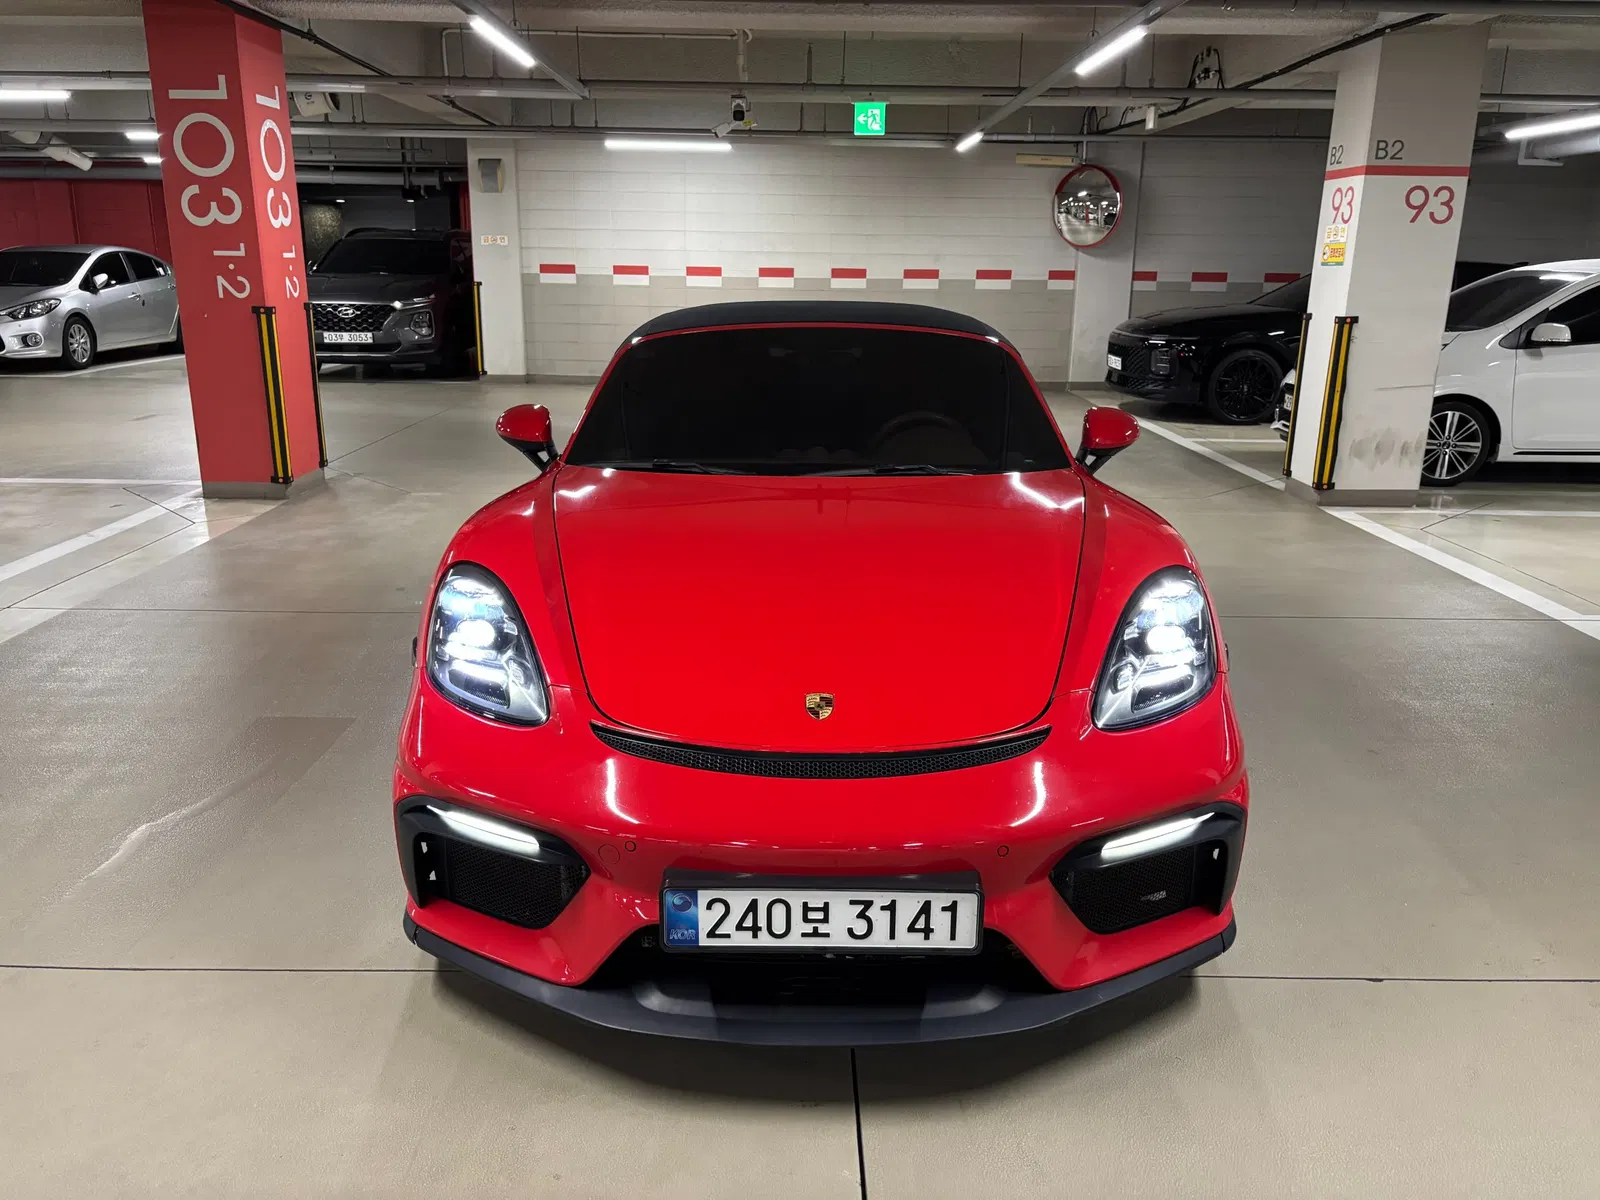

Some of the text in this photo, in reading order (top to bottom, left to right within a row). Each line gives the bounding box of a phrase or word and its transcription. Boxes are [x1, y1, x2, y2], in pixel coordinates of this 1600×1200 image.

[168, 74, 242, 227] 103
[255, 85, 291, 229] 103
[1329, 145, 1344, 165] B2
[1375, 140, 1405, 160] B2
[1331, 185, 1355, 224] 93
[1404, 185, 1455, 224] 93
[669, 929, 696, 940] KOR
[705, 897, 959, 941] 240보 3141
